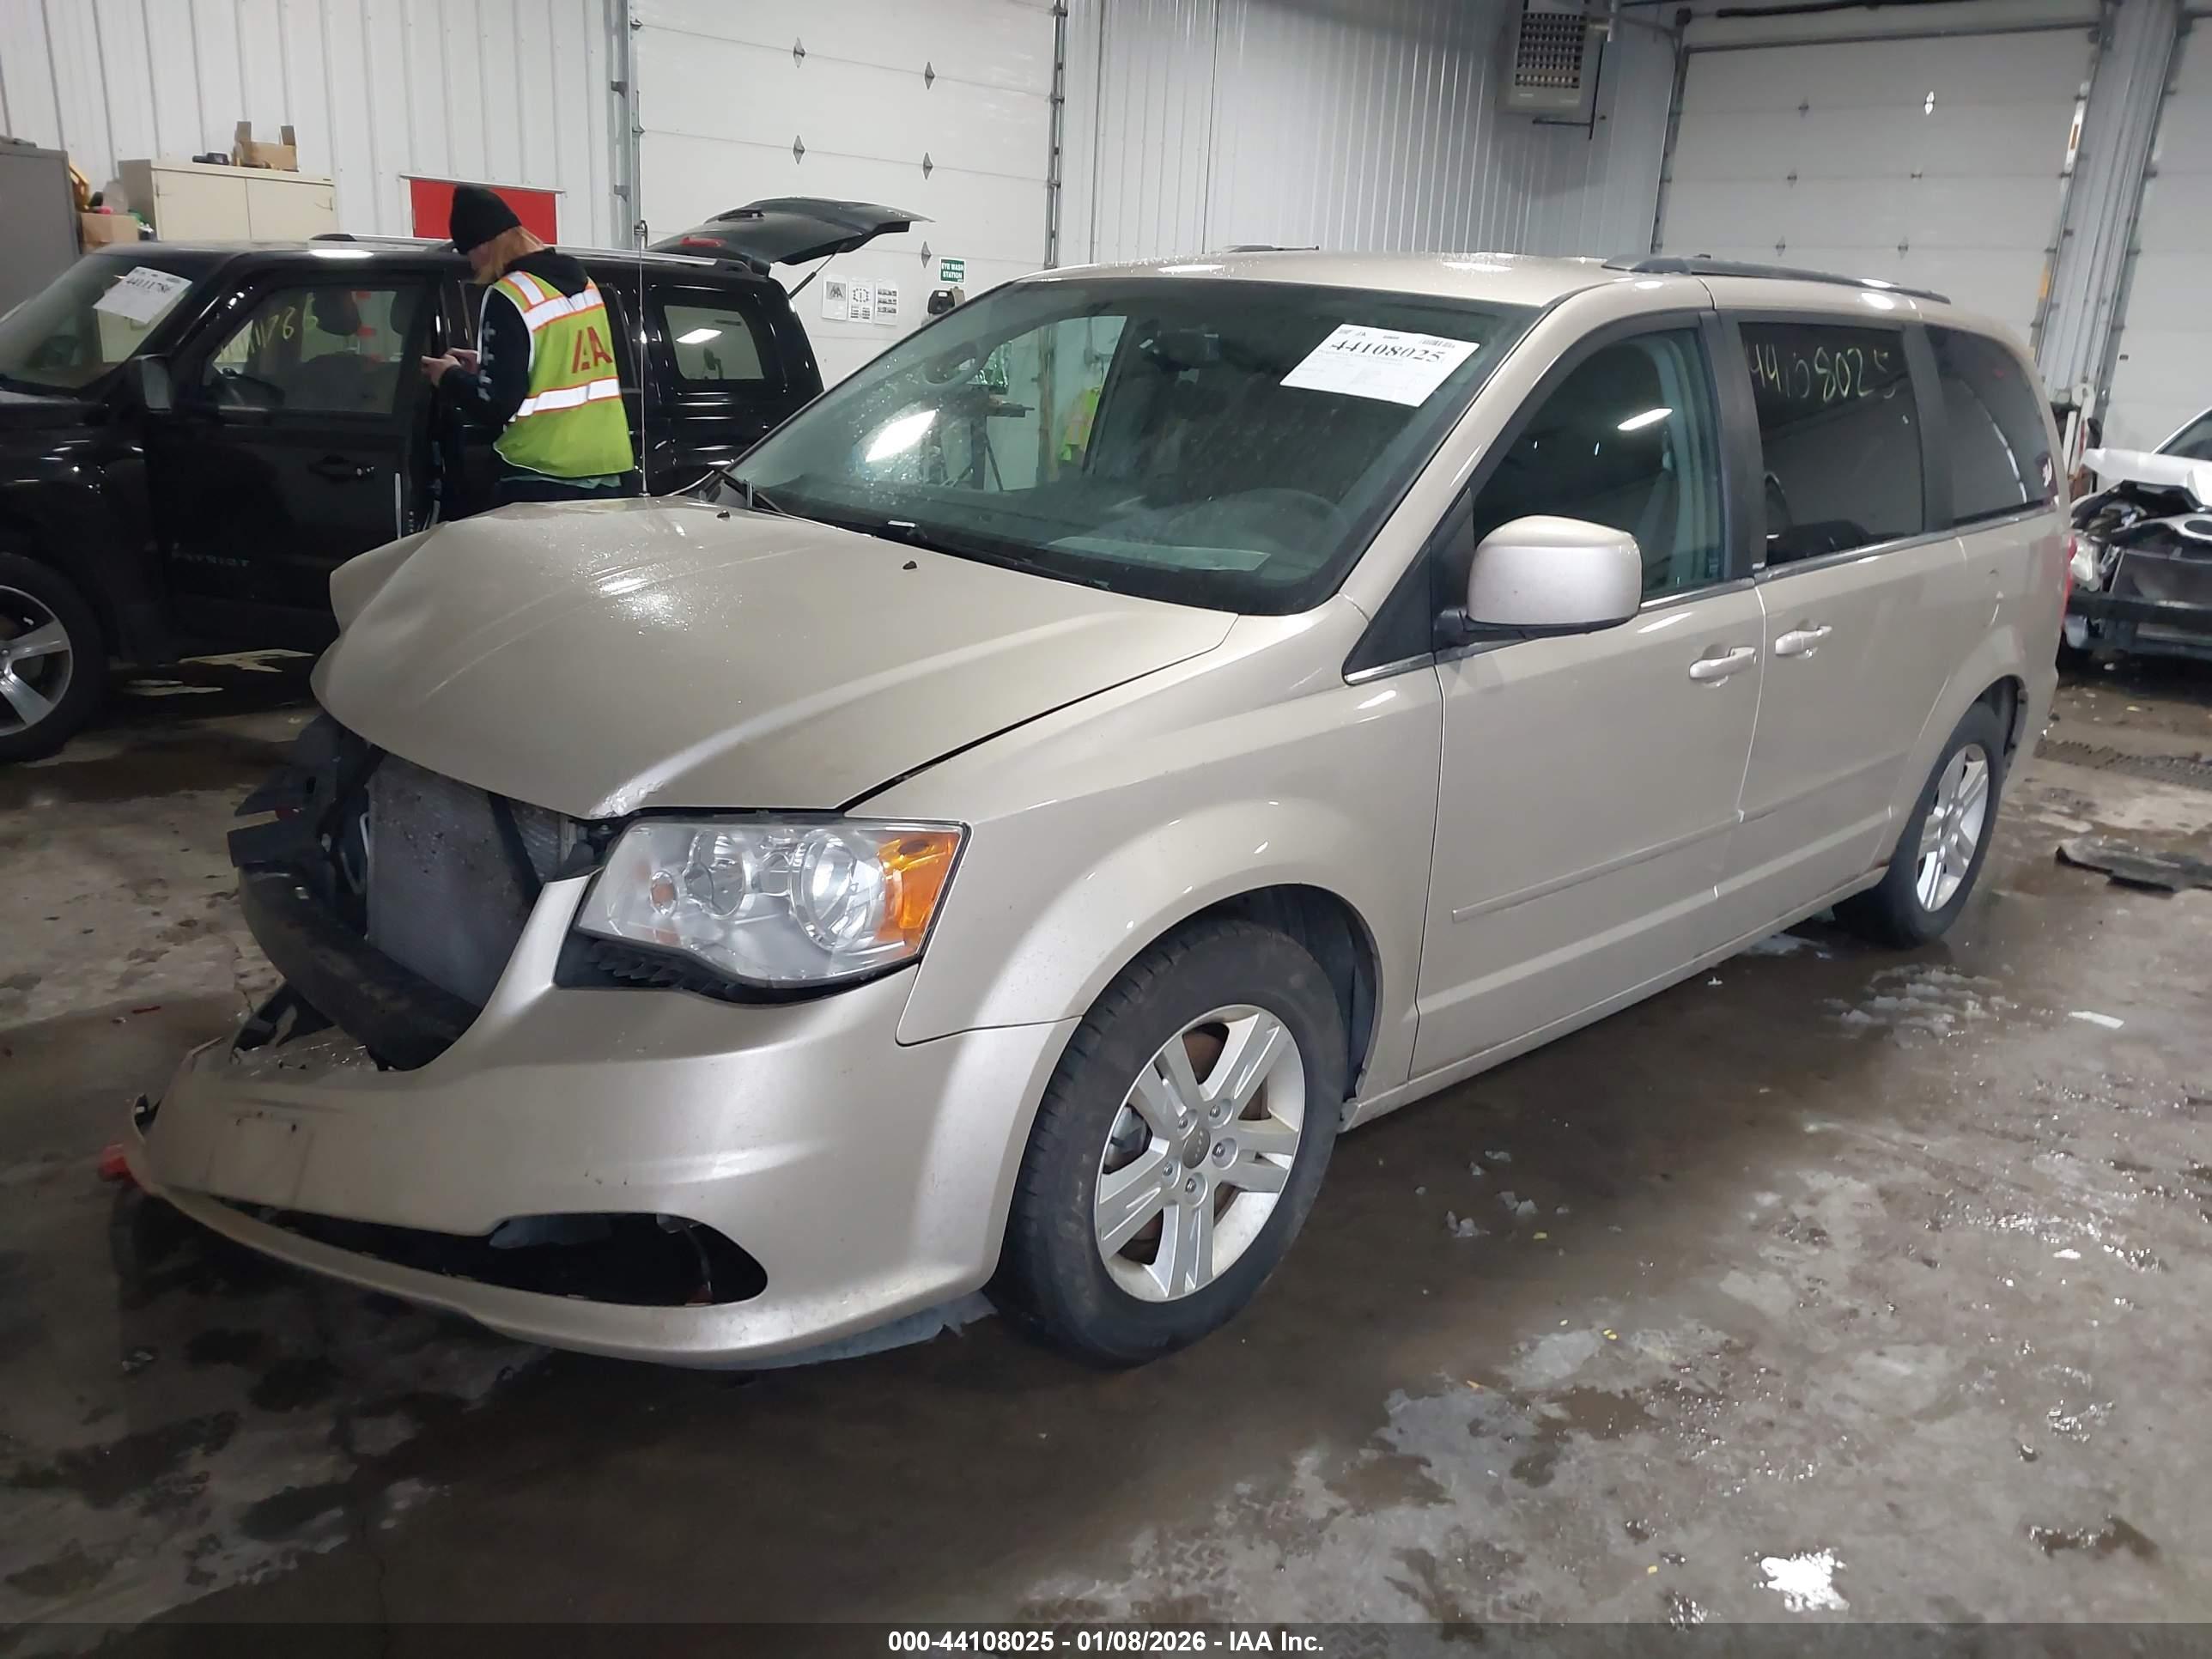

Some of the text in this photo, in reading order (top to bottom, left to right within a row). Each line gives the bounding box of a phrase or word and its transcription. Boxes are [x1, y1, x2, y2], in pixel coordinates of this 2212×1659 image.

[951, 263, 963, 271] WASH
[943, 270, 963, 279] STATION
[1331, 340, 1445, 362] 44108025
